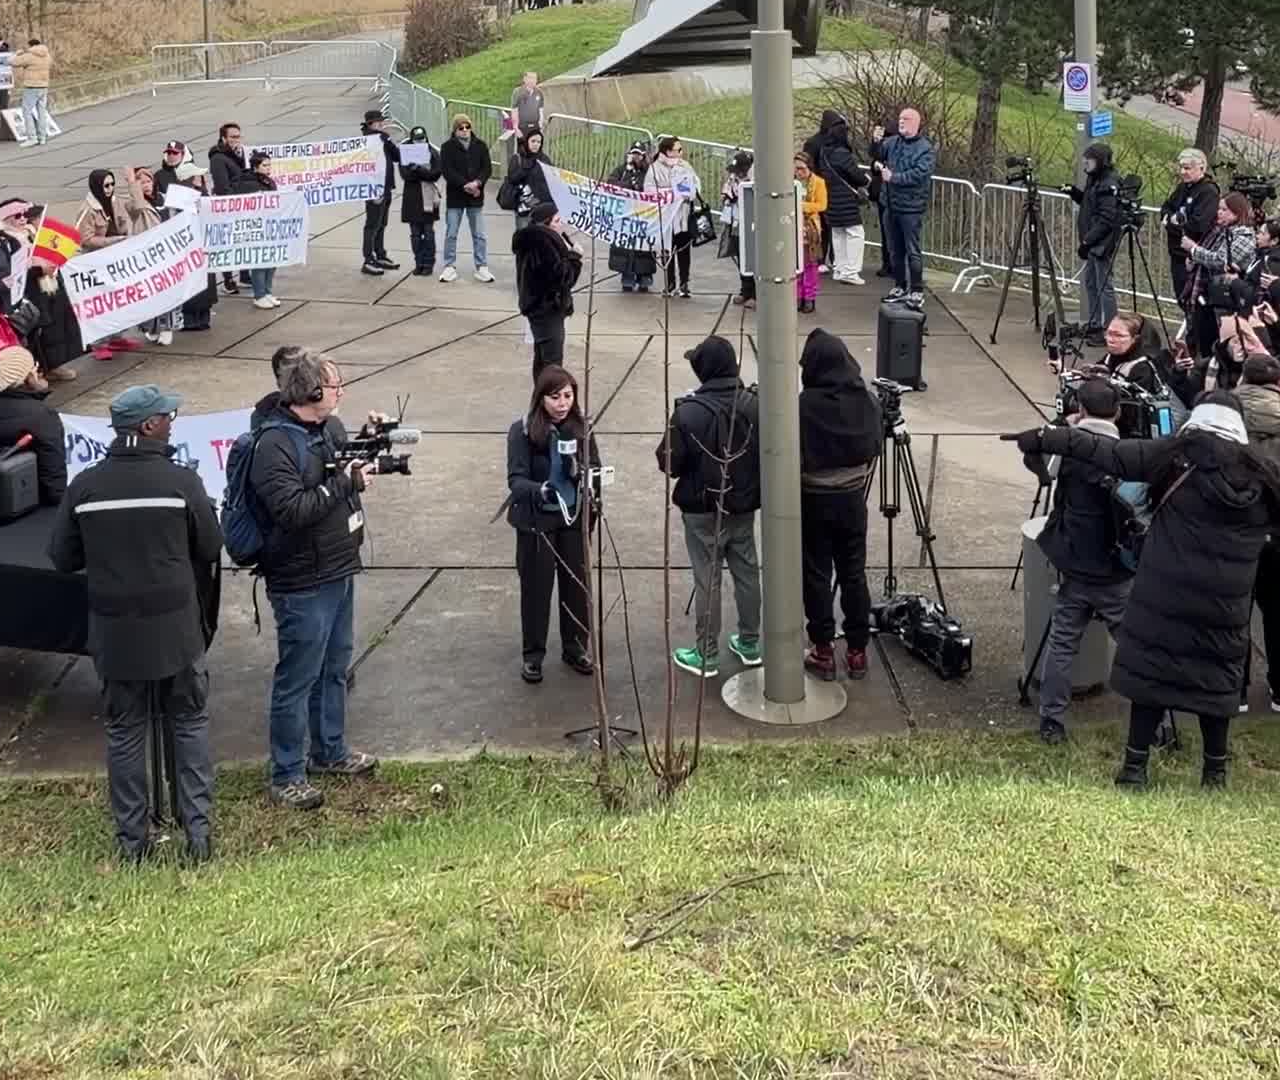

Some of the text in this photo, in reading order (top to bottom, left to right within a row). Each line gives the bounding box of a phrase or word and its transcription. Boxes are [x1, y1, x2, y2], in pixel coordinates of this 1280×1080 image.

[228, 199, 241, 213] DO
[242, 196, 263, 211] NOT
[264, 195, 280, 209] LET
[621, 217, 649, 238] FOR
[70, 225, 195, 293] THE PHILIPPINES
